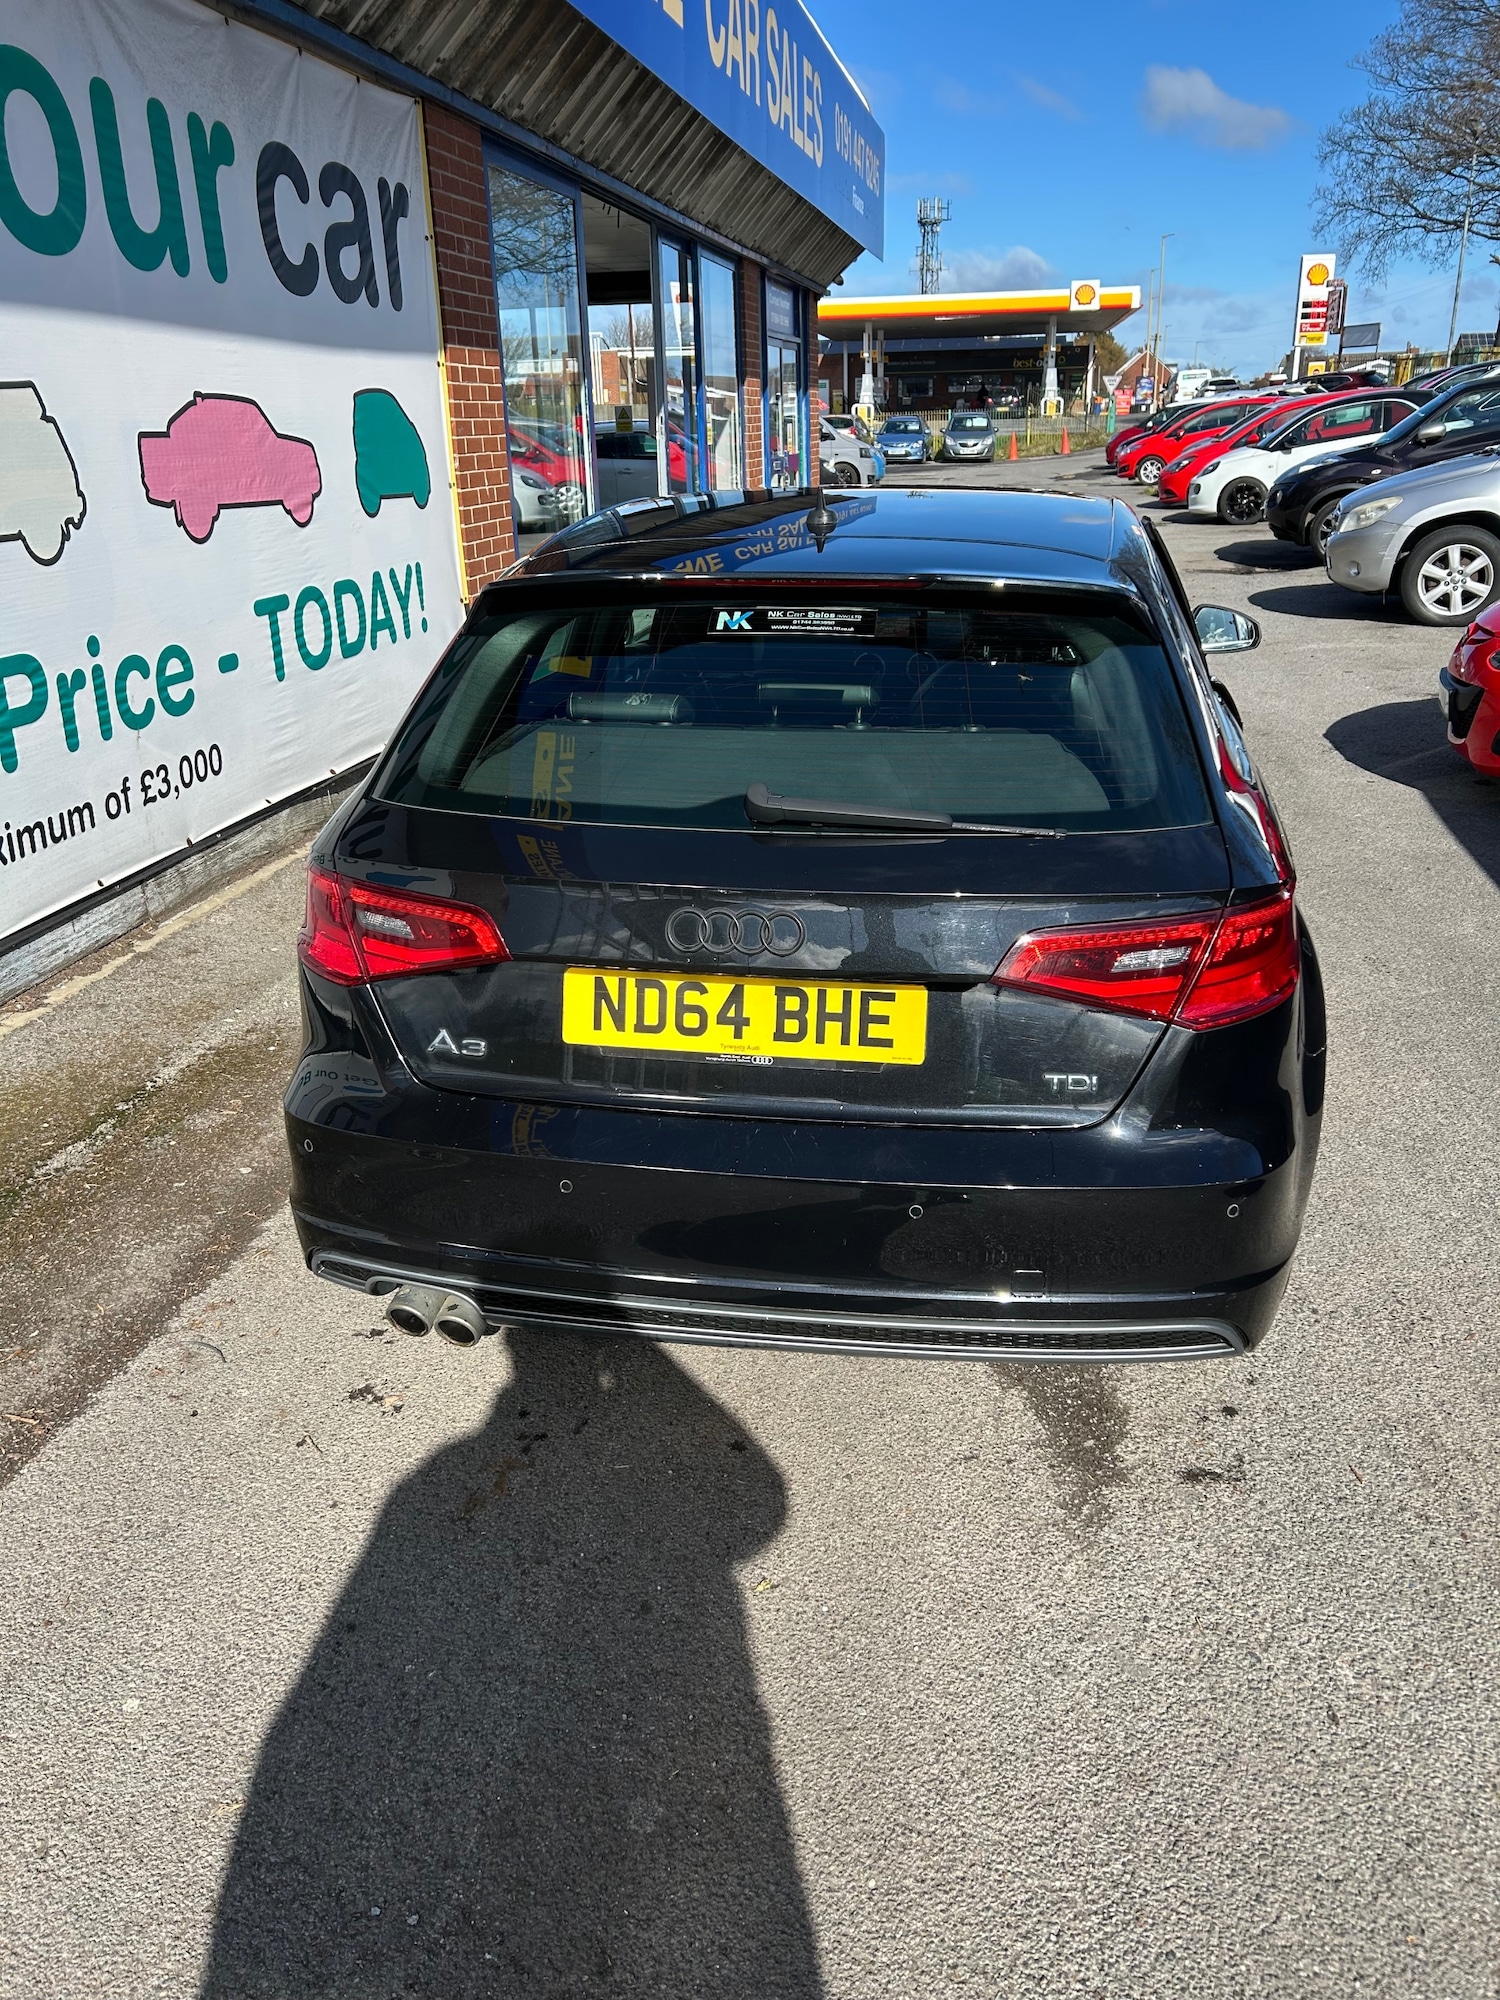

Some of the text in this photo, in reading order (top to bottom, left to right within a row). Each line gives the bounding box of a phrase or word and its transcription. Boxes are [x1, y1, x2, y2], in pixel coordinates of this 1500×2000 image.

[766, 8, 823, 168] SALES
[835, 102, 852, 166] 0191
[853, 128, 866, 180] 447
[256, 141, 409, 312] car
[1013, 358, 1045, 368] best-o
[716, 611, 754, 631] NK
[808, 611, 836, 619] Sales
[0, 561, 429, 773] Price - TODAY!
[105, 776, 131, 820] of
[140, 743, 223, 807] £3,000
[593, 976, 897, 1048] ND64 BHE
[426, 1028, 487, 1057] A3
[720, 1043, 746, 1051] Tyneside
[1042, 1073, 1098, 1092] TDI
